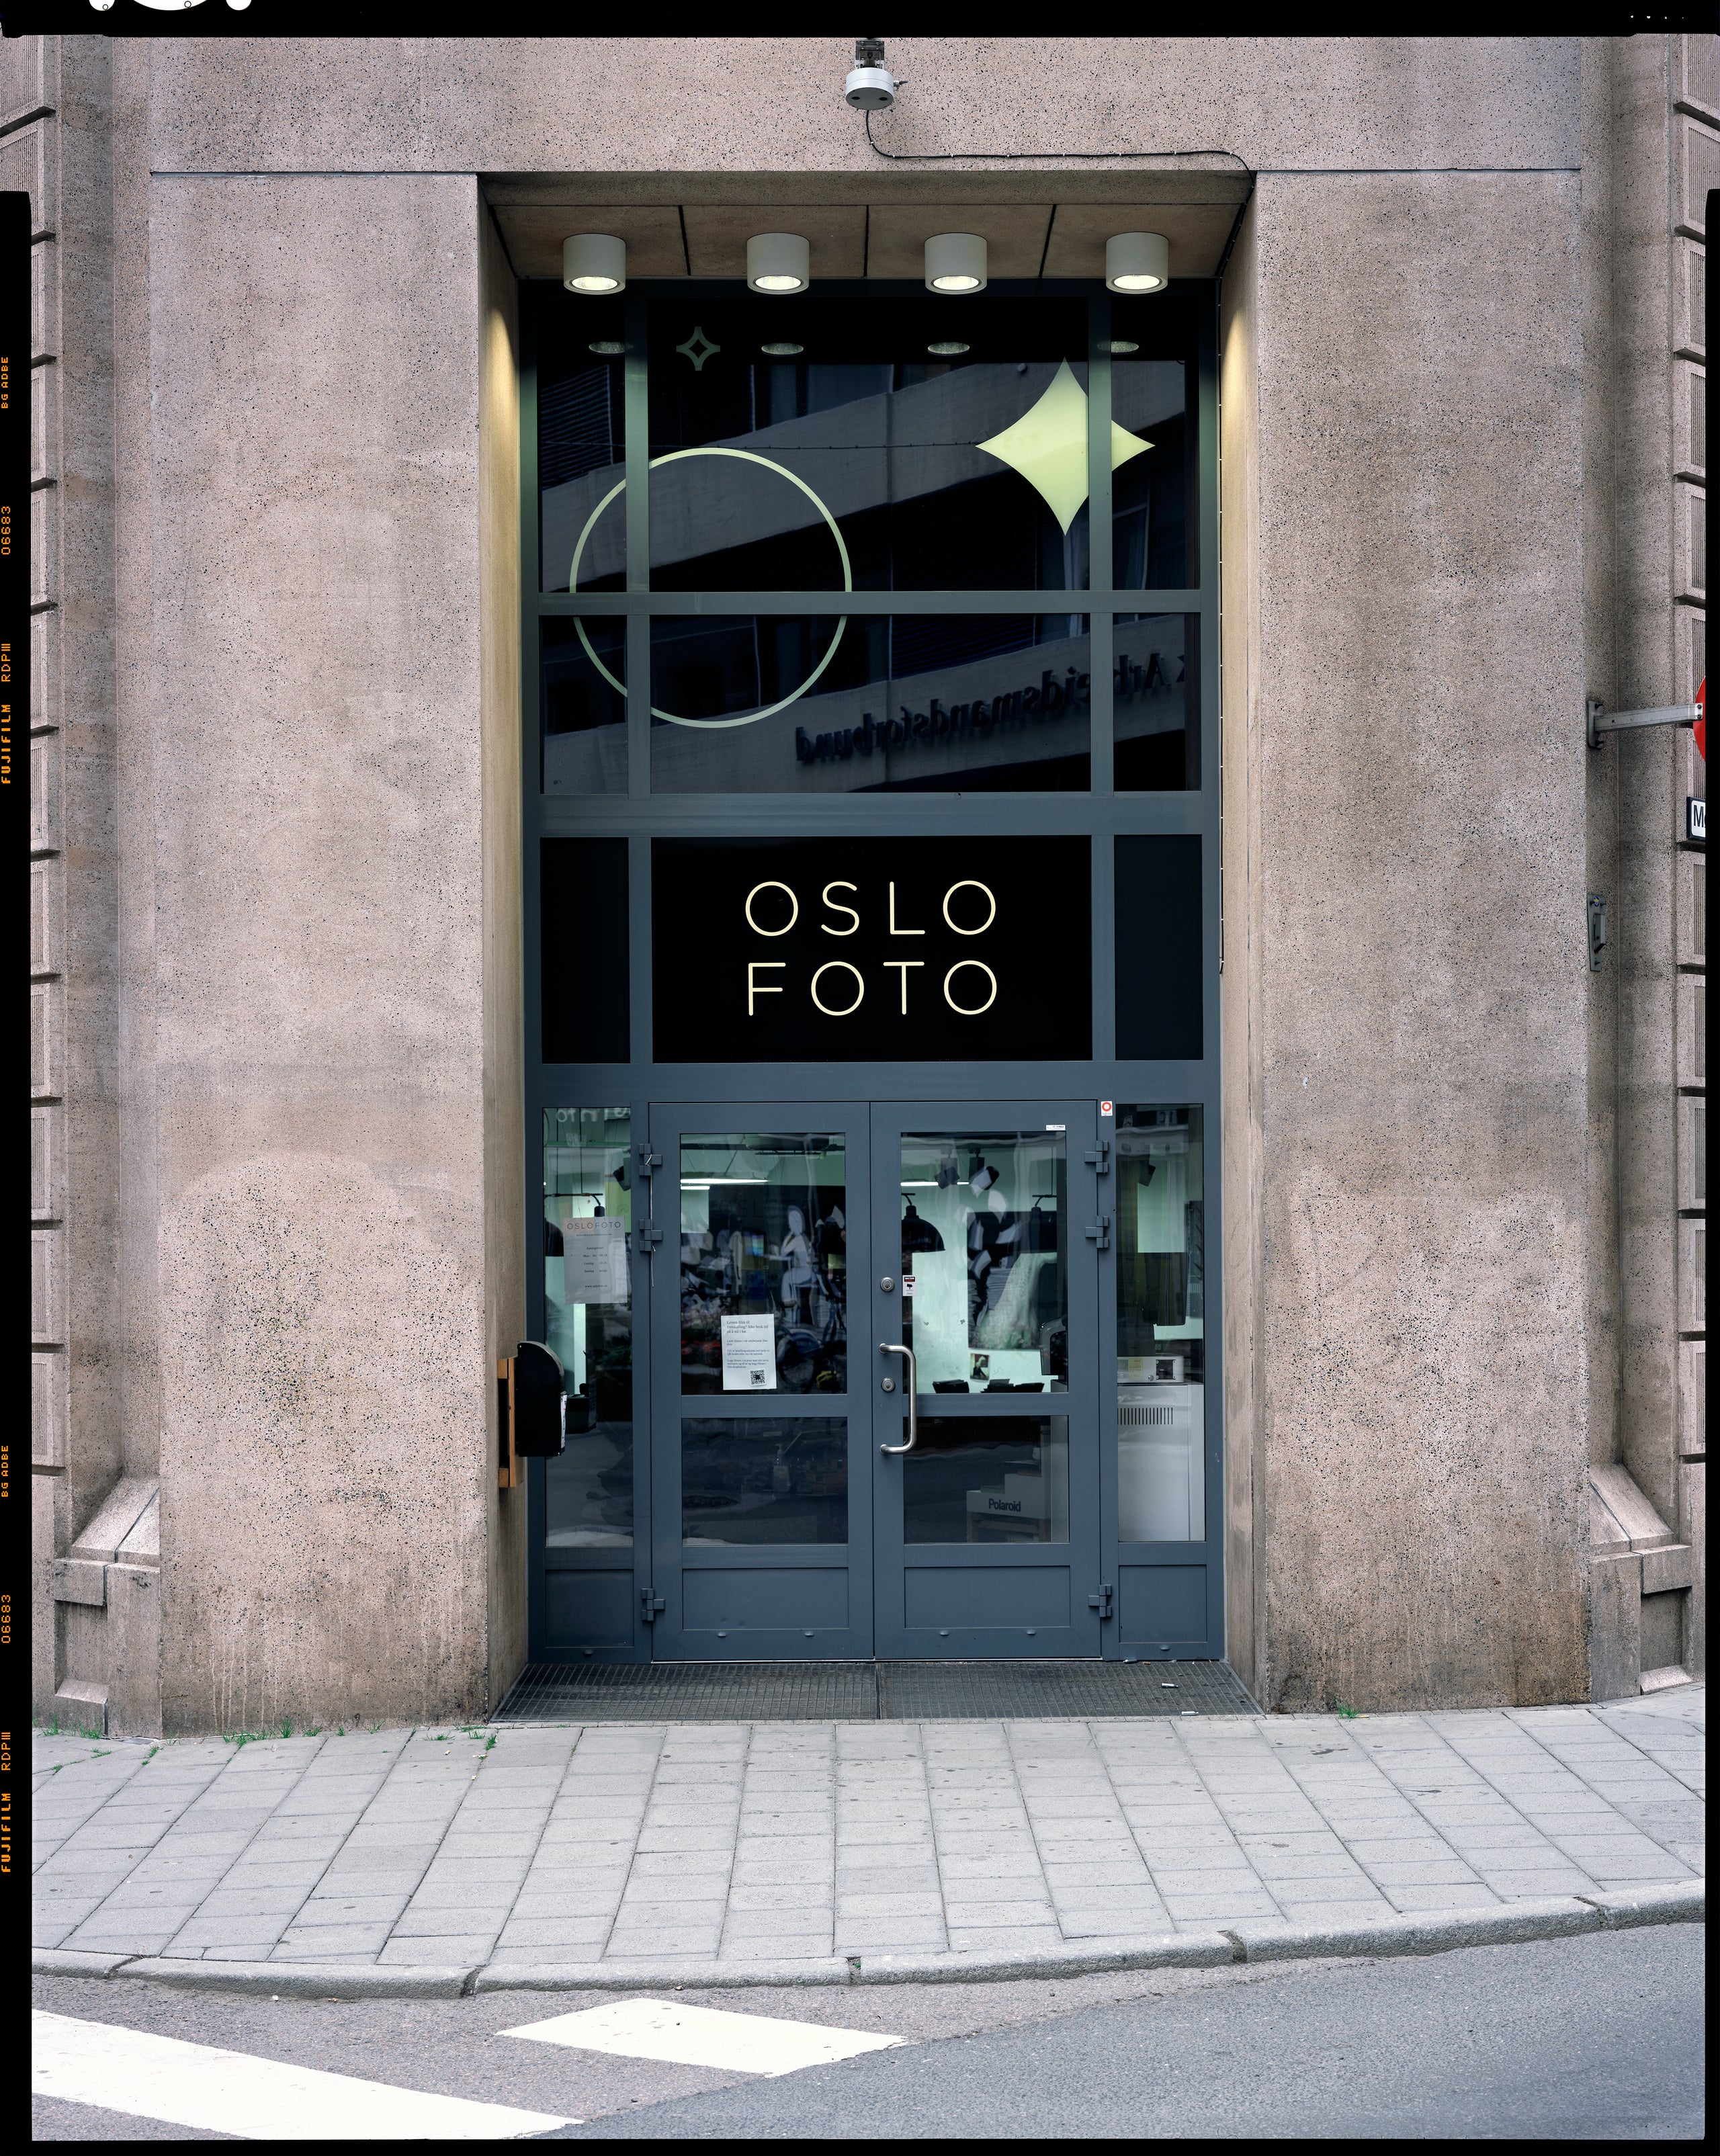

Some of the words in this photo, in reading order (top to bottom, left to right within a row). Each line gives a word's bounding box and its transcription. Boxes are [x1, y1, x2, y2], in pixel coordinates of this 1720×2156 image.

[1, 394, 9, 409] BG
[1, 507, 11, 555] 06683
[1, 705, 11, 784] FUJIFILM
[1693, 804, 1706, 828] M
[745, 880, 996, 937] OSLO
[748, 960, 997, 1017] FOTO
[1, 1483, 9, 1498] BG
[988, 1498, 1021, 1512] Polaroid
[1, 1595, 11, 1644] 06683
[1, 1793, 11, 1872] FUJIFILM
